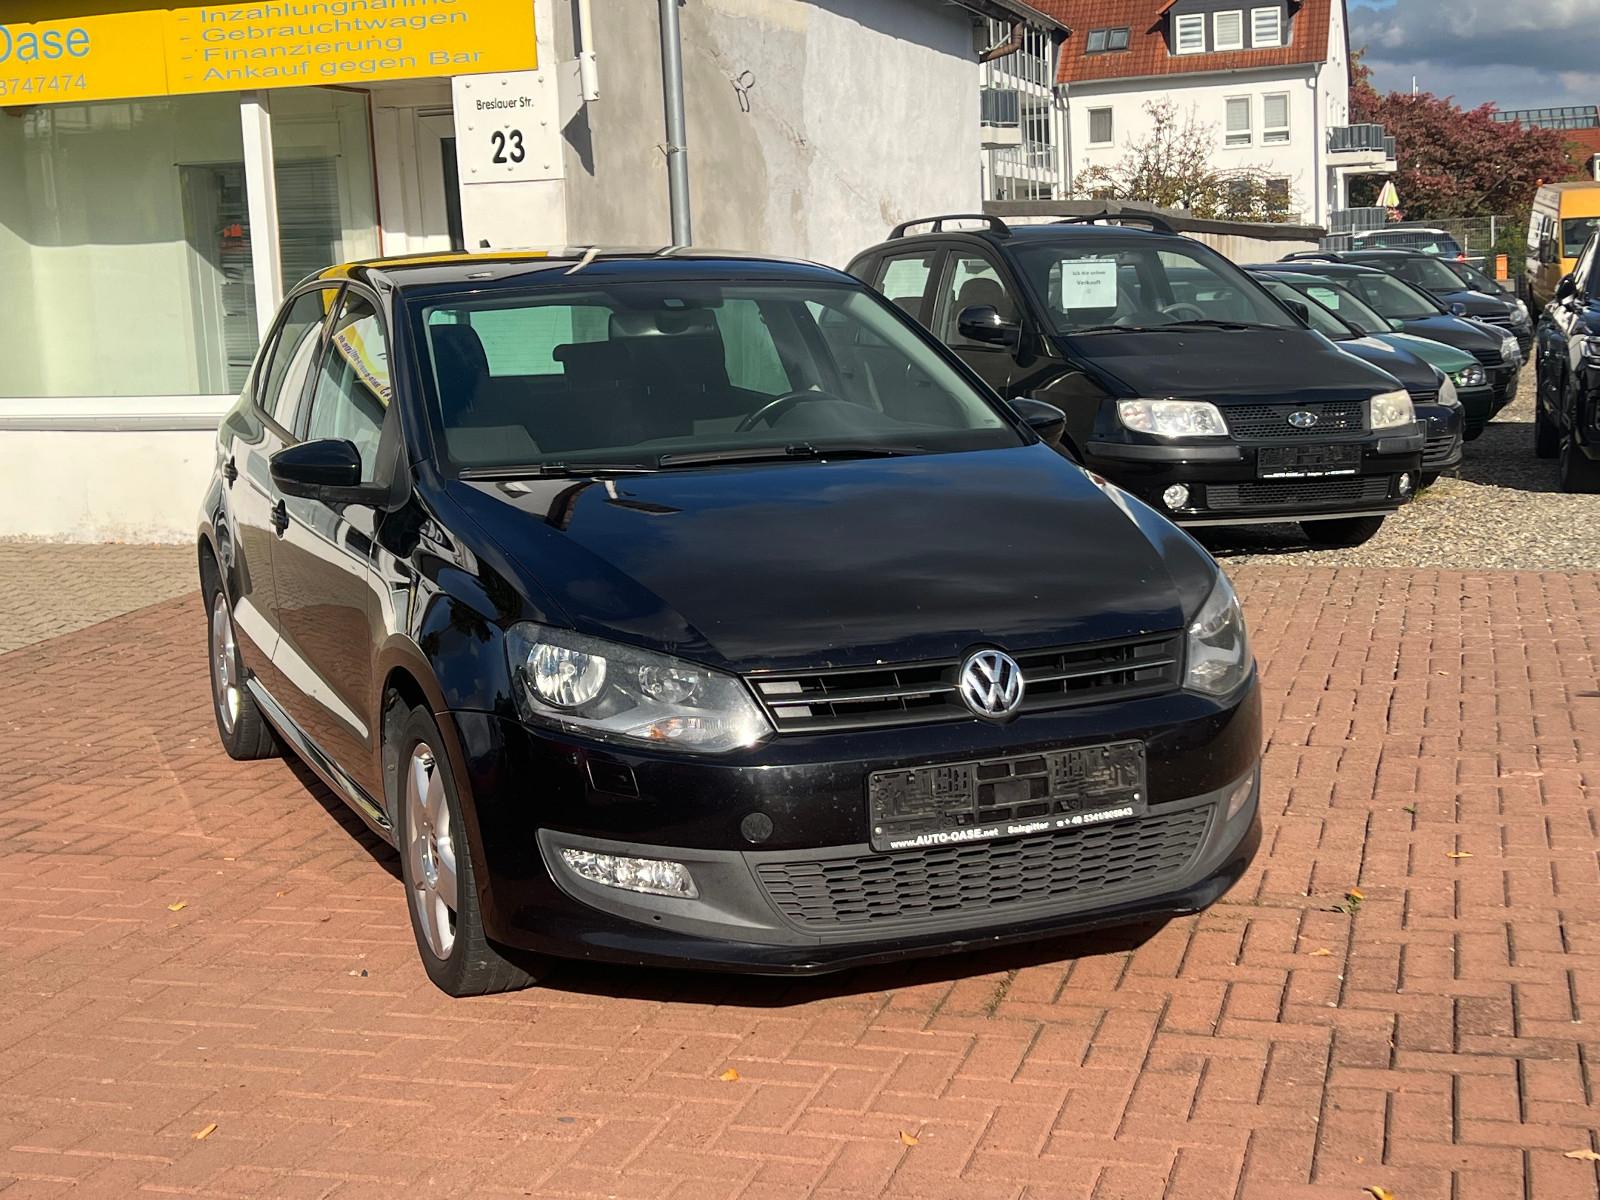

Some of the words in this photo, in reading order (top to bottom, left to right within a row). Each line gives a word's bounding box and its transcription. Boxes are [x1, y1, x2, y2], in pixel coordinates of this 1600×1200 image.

[202, 11, 468, 42] Gebrauchtwagen
[204, 37, 402, 62] Finanzierung
[204, 61, 310, 81] Ankauf
[320, 56, 416, 76] gegen
[429, 50, 485, 65] Bar
[476, 97, 517, 110] Breslauer
[519, 96, 534, 108] Str.
[491, 129, 526, 164] 23
